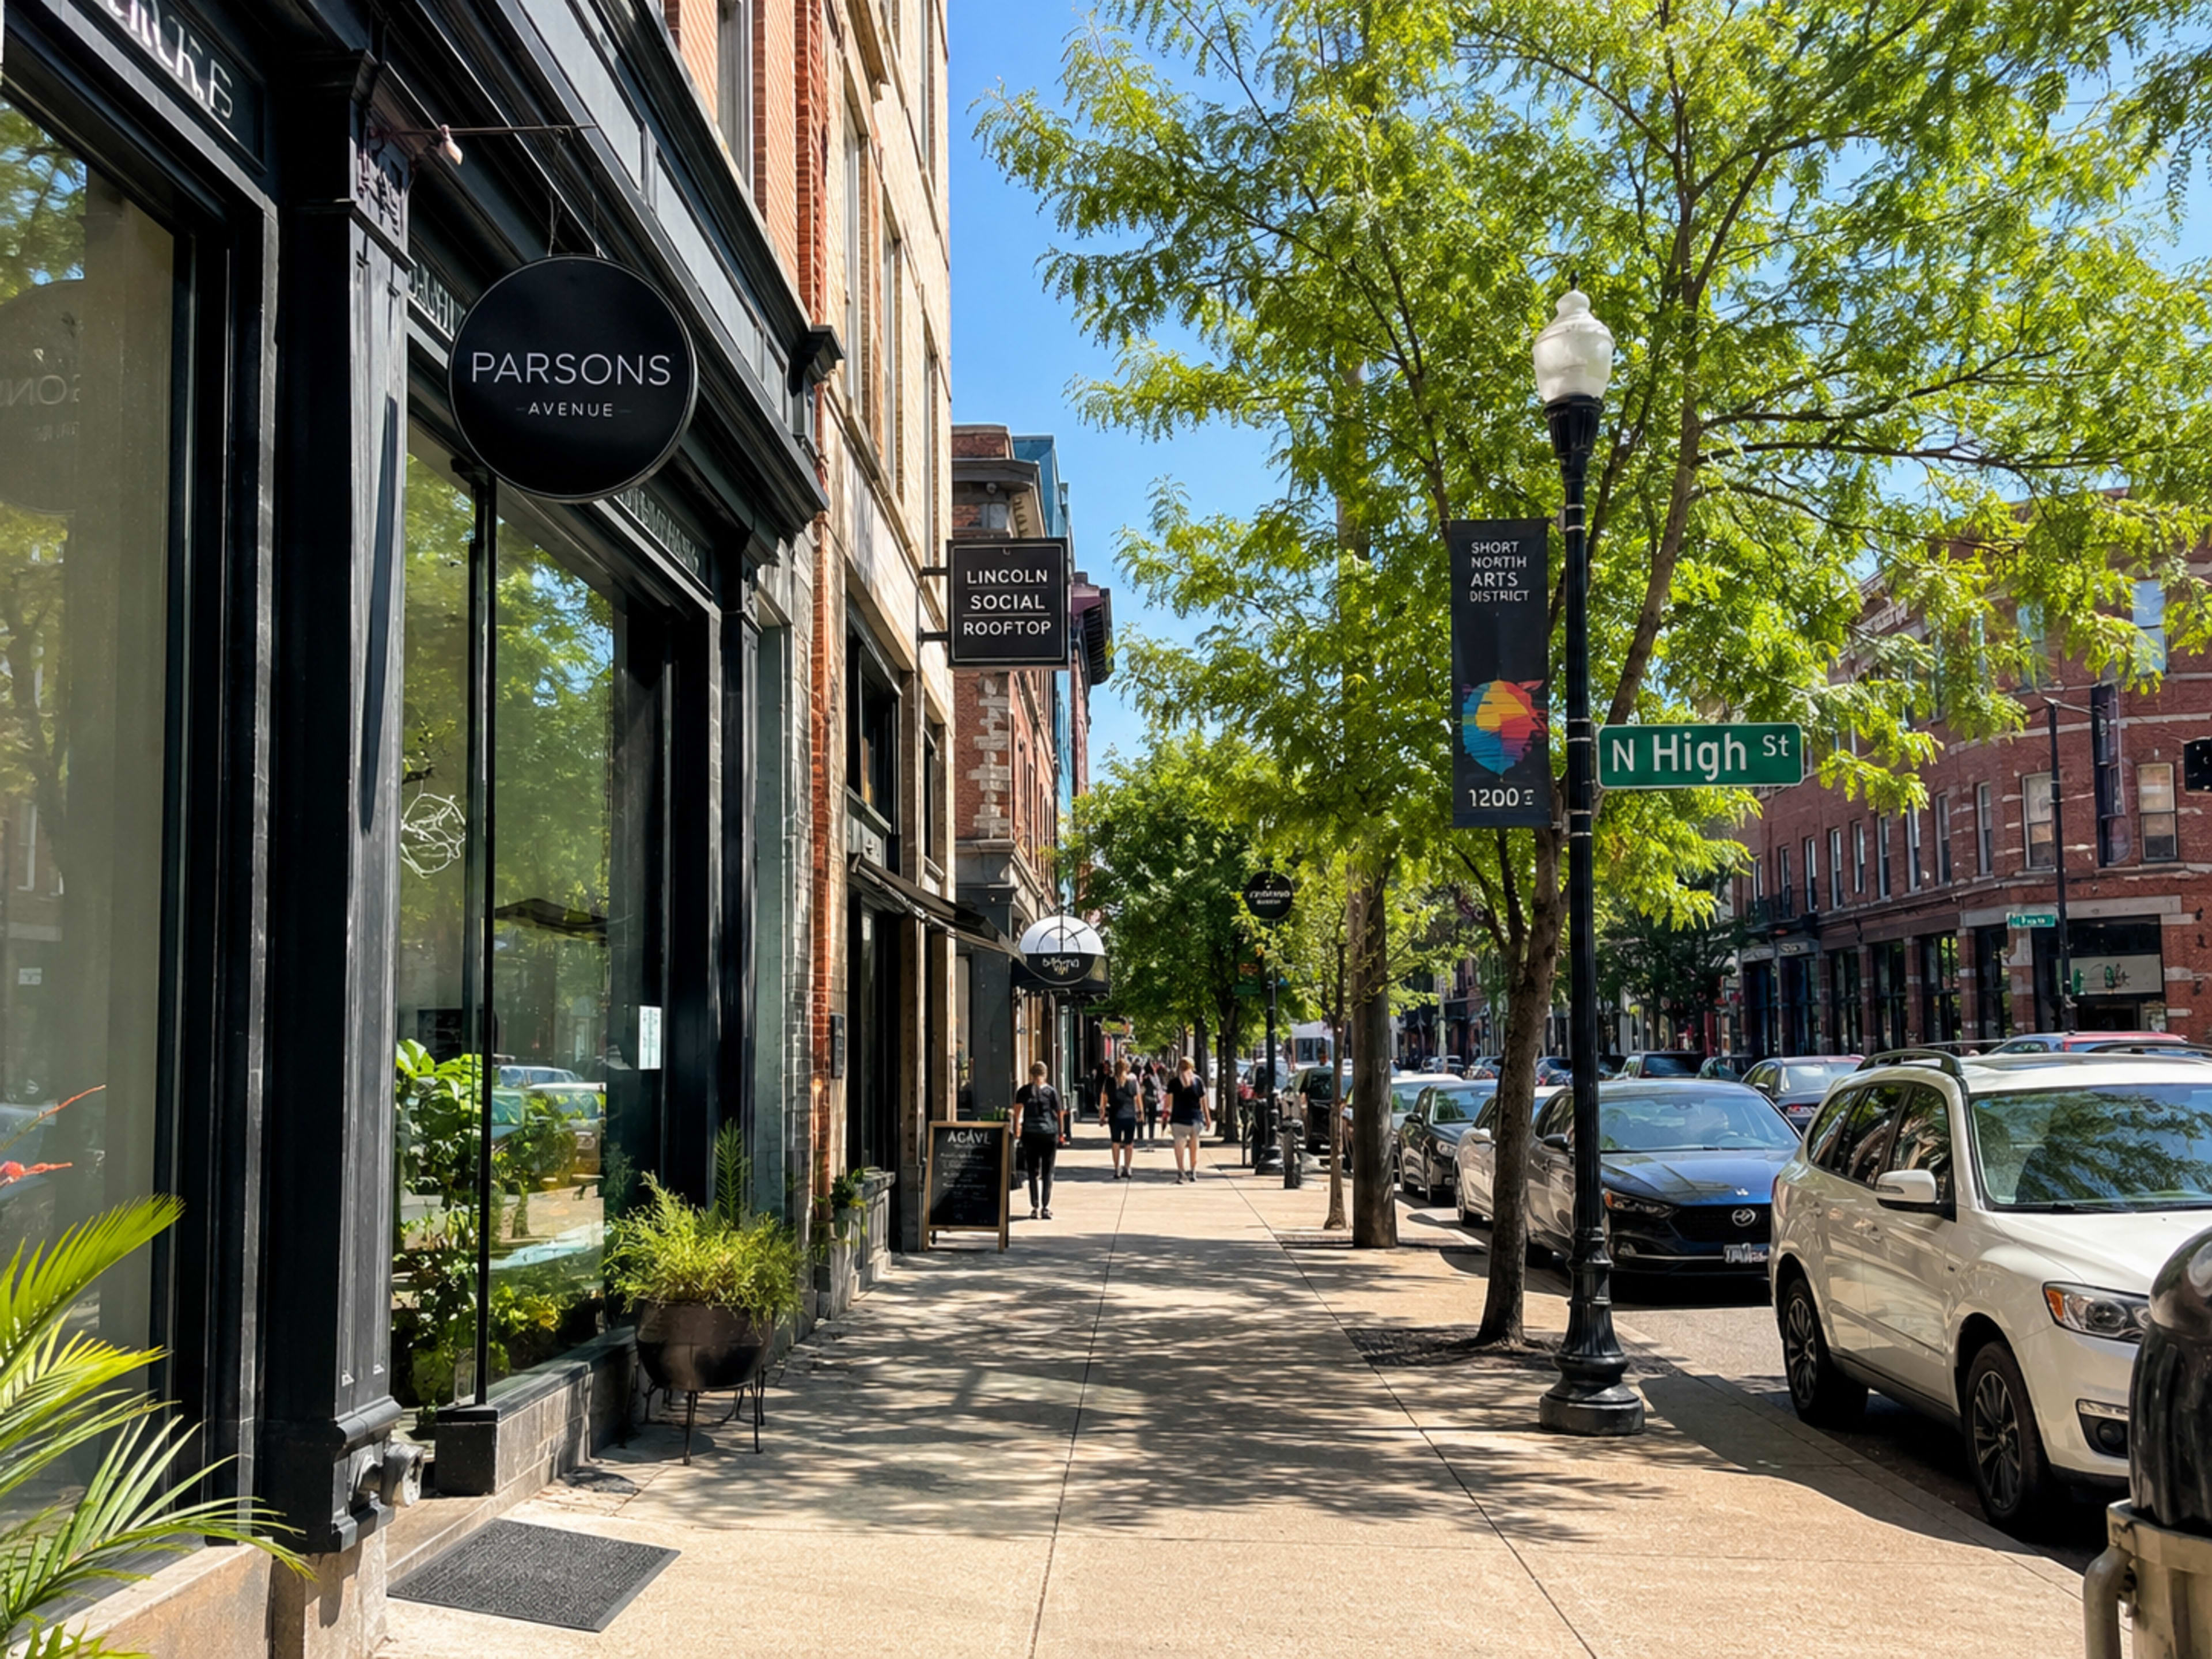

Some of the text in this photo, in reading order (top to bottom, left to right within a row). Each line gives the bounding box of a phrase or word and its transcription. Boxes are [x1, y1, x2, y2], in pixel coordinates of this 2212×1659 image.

[473, 352, 671, 385] PARSONS
[528, 403, 612, 417] AVENUE
[1471, 541, 1519, 554] SHORT
[967, 569, 1047, 584] LINCOLN
[1471, 571, 1518, 587] ARTS
[971, 594, 1045, 609] SOCIAL
[1469, 590, 1529, 603] DISTRICT
[964, 620, 1051, 635] ROOFTOP
[1612, 732, 1789, 781] N High St
[1469, 787, 1519, 807] 1200
